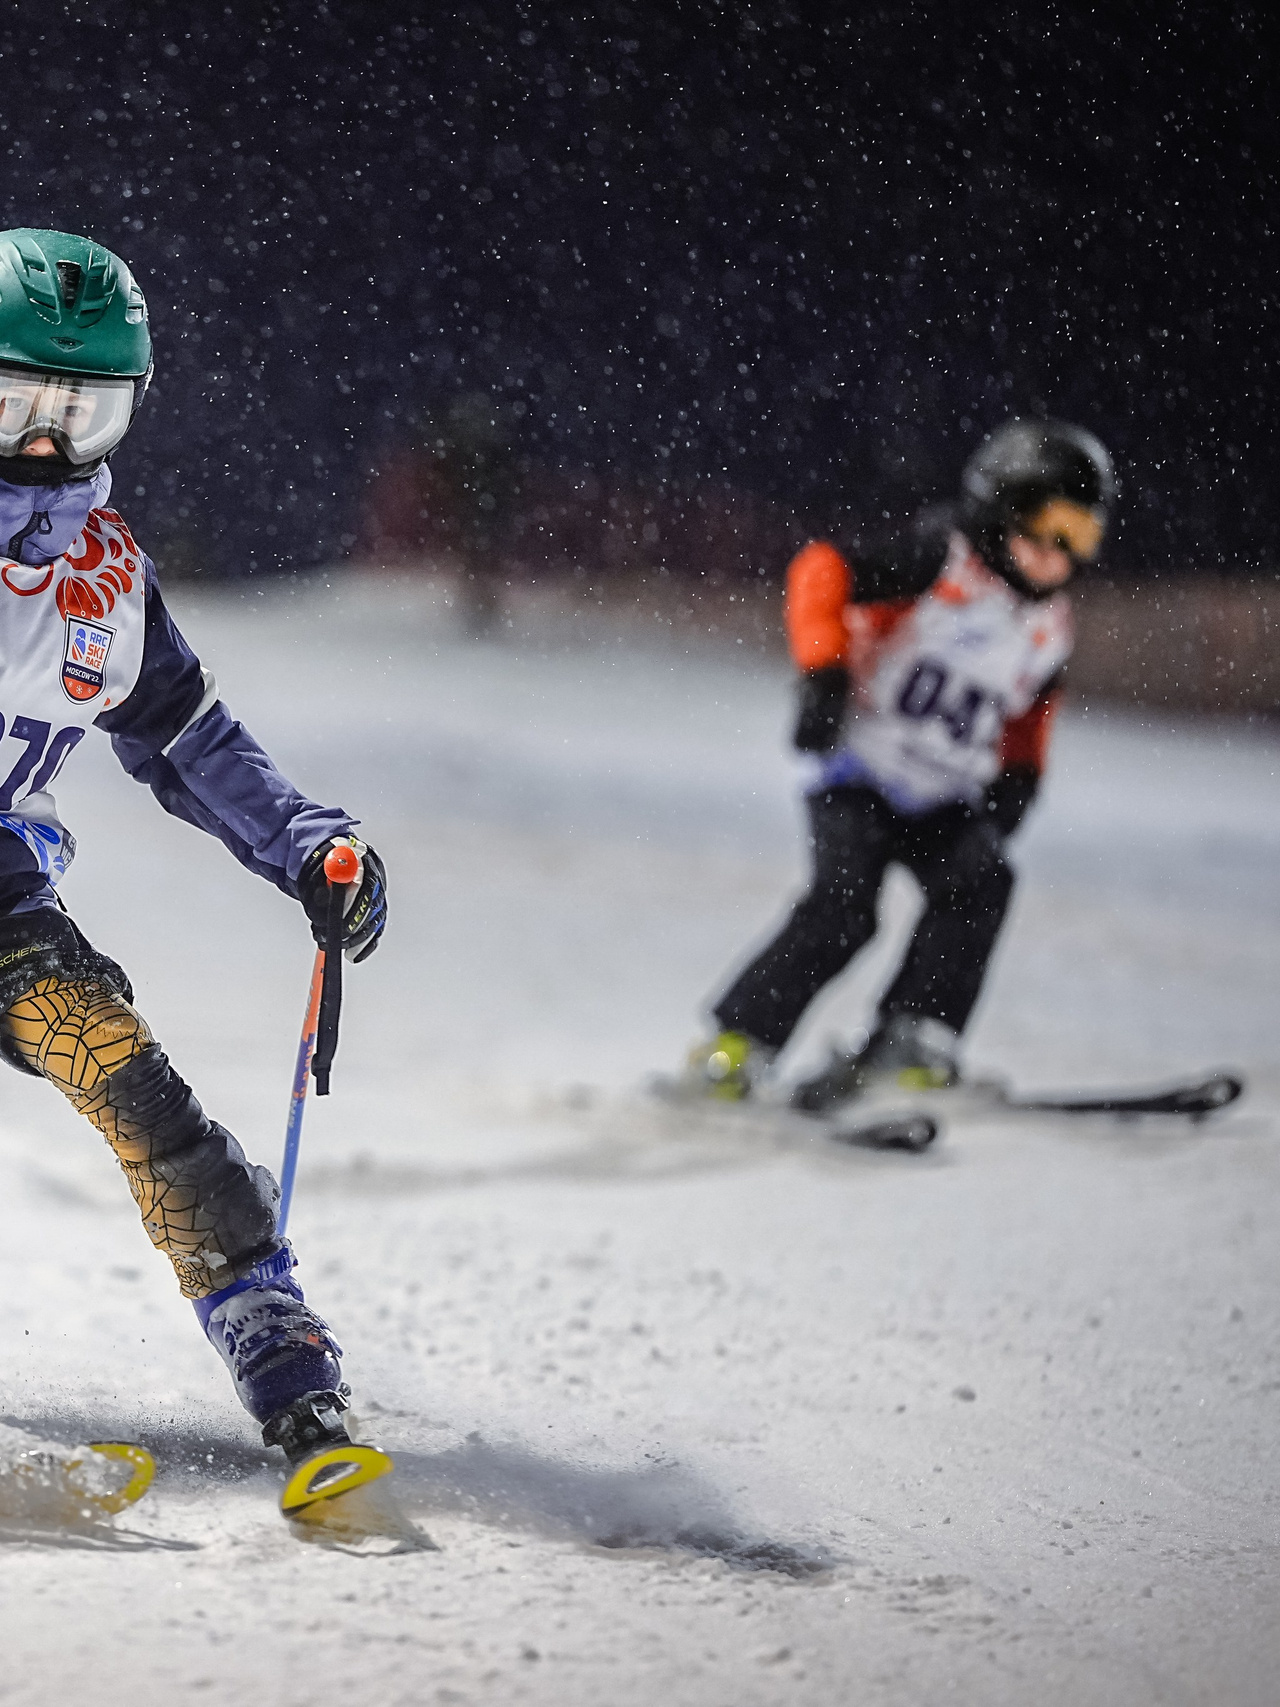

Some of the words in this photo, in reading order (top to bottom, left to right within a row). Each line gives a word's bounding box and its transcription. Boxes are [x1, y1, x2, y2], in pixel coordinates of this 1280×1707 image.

[89, 631, 108, 648] RRC
[87, 643, 105, 660] SKI
[85, 656, 102, 670] RACE
[65, 666, 100, 684] MOSCOW'22
